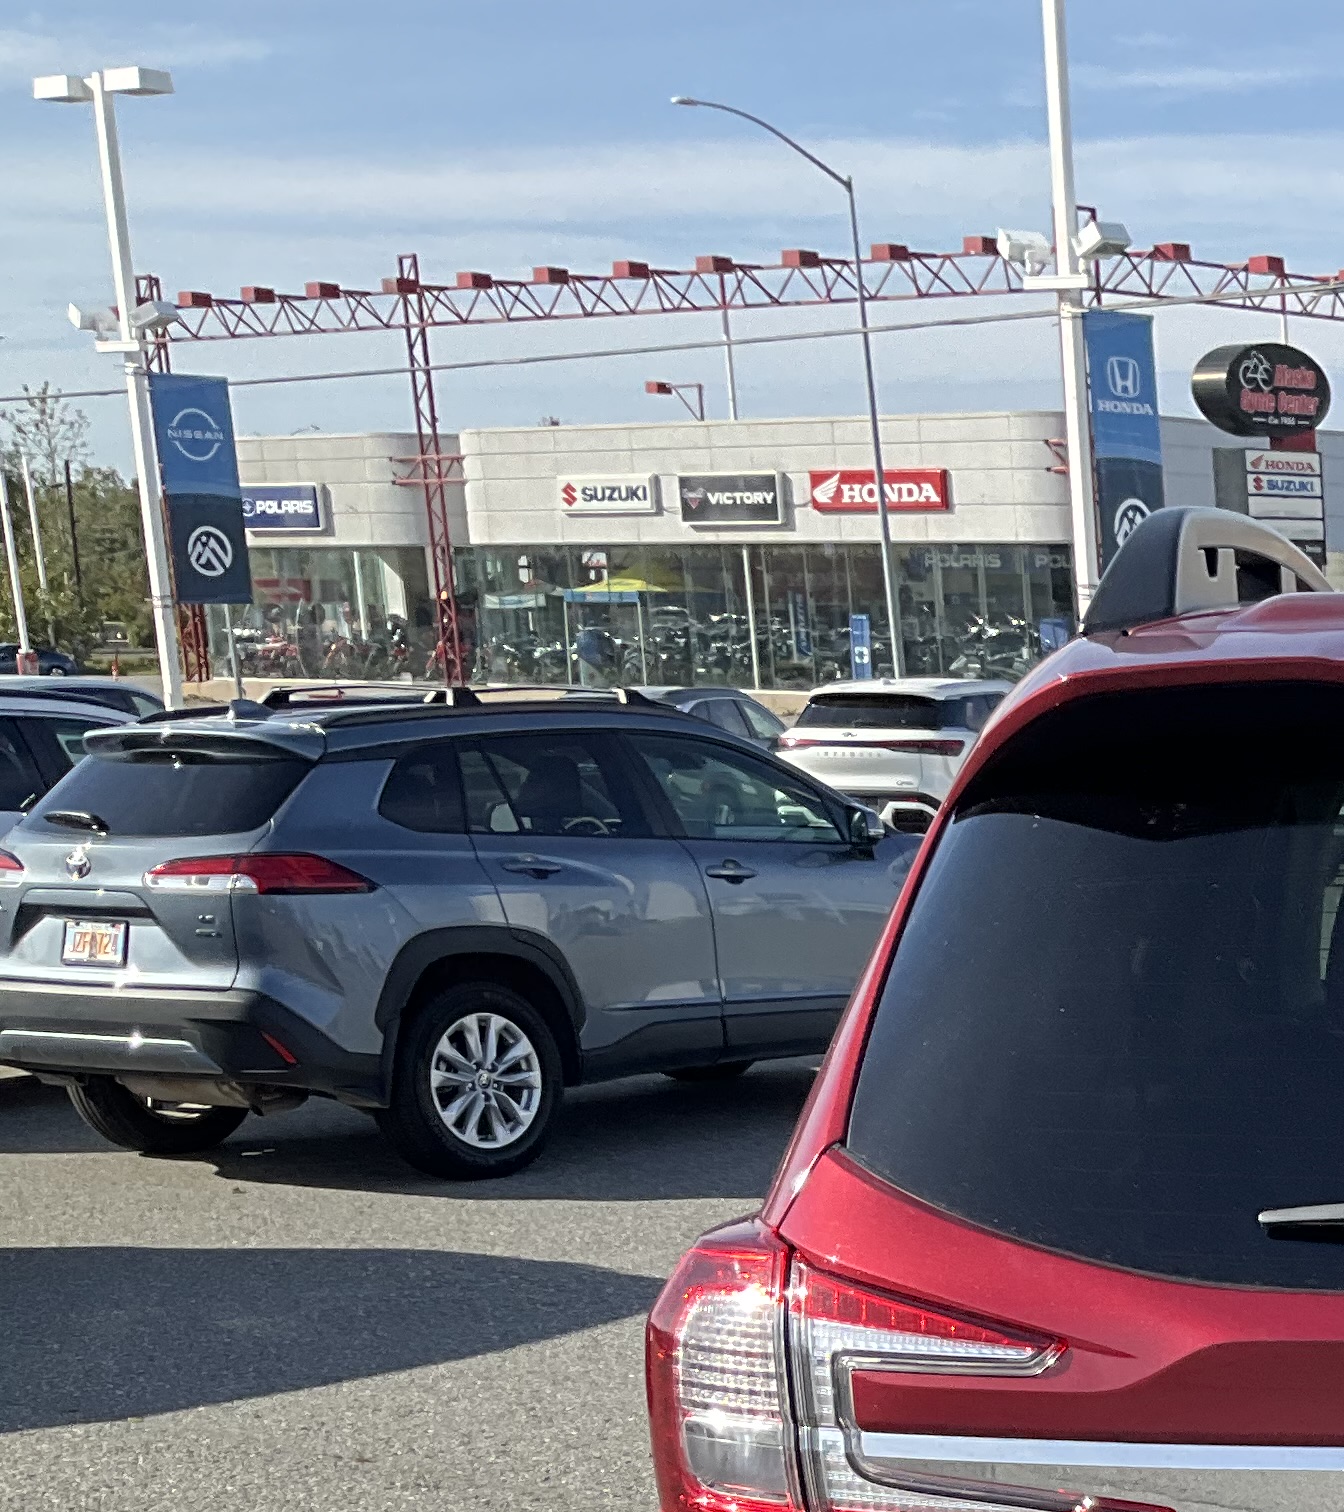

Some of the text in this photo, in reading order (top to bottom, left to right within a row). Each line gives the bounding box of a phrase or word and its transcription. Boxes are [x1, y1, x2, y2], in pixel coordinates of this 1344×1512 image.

[1098, 400, 1154, 416] HONDA
[167, 428, 224, 440] NISSAN
[1265, 458, 1315, 472] HONDA
[841, 483, 941, 503] HONDA
[1266, 479, 1314, 493] SUZUKI
[581, 485, 648, 503] SUZUKI
[707, 491, 774, 505] VICTORY
[256, 500, 314, 514] POLARIS
[924, 554, 1001, 568] POLARIS
